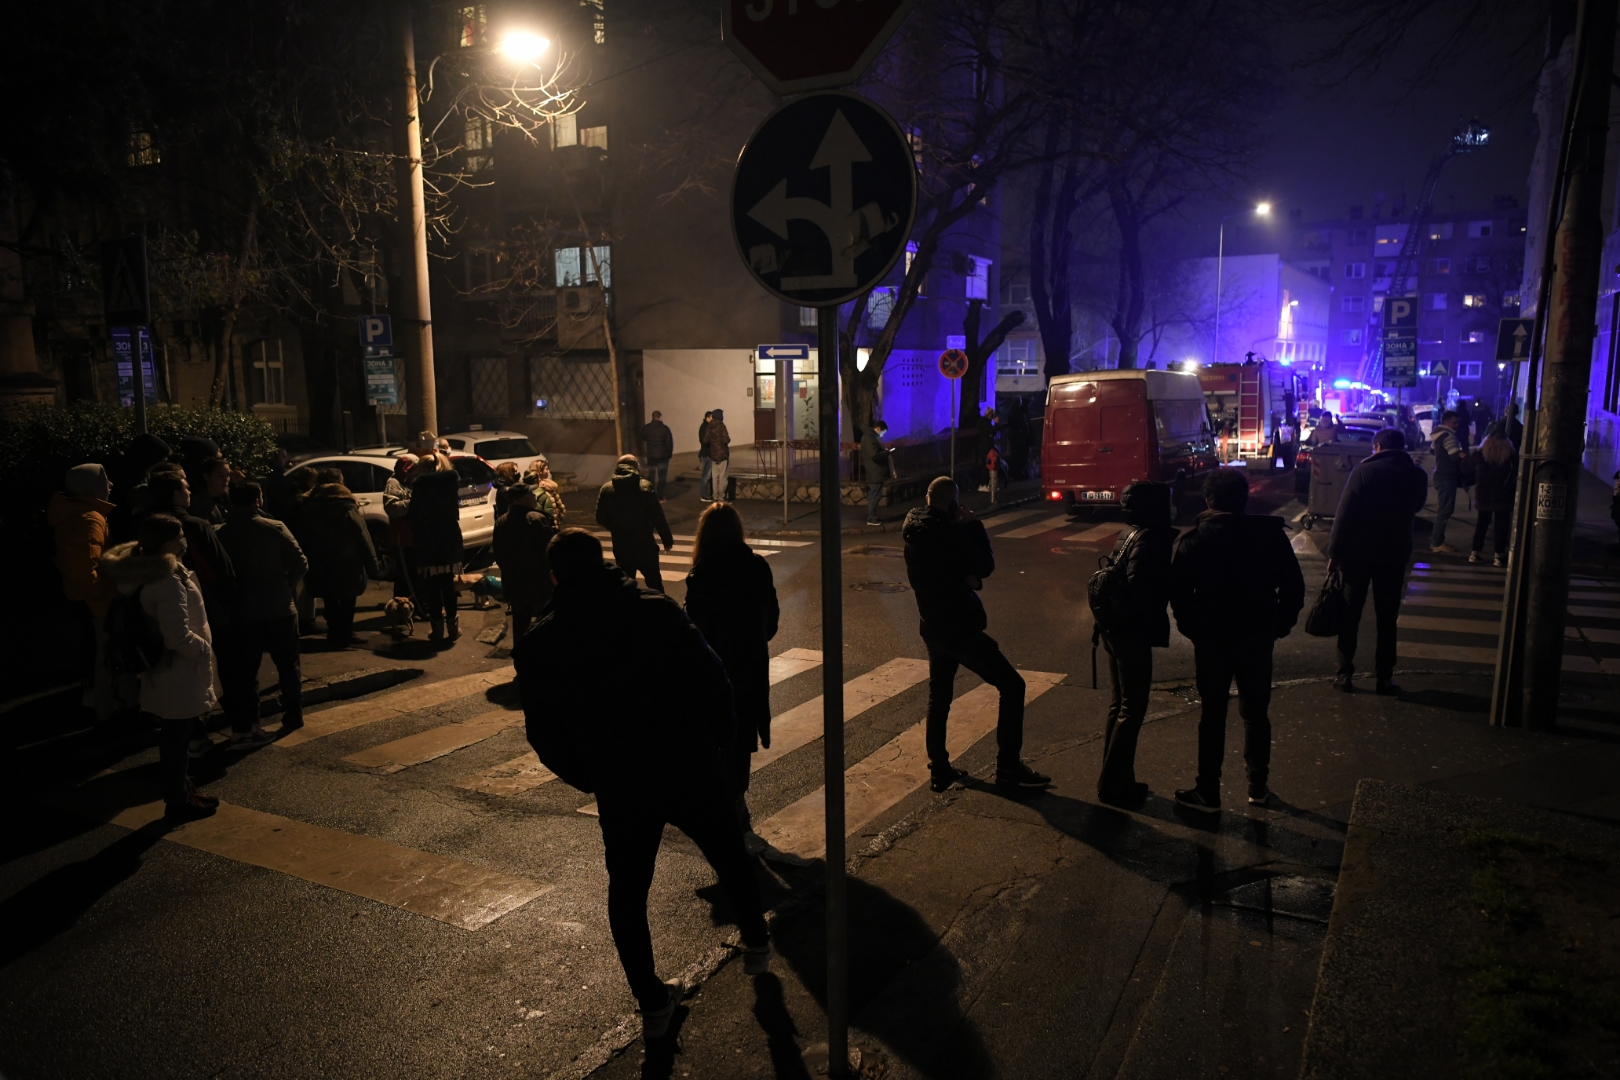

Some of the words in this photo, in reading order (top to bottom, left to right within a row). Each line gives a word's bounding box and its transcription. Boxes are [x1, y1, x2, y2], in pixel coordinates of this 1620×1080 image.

[1391, 300, 1411, 325] P
[366, 318, 385, 343] P
[1385, 342, 1407, 350] ЗОНА
